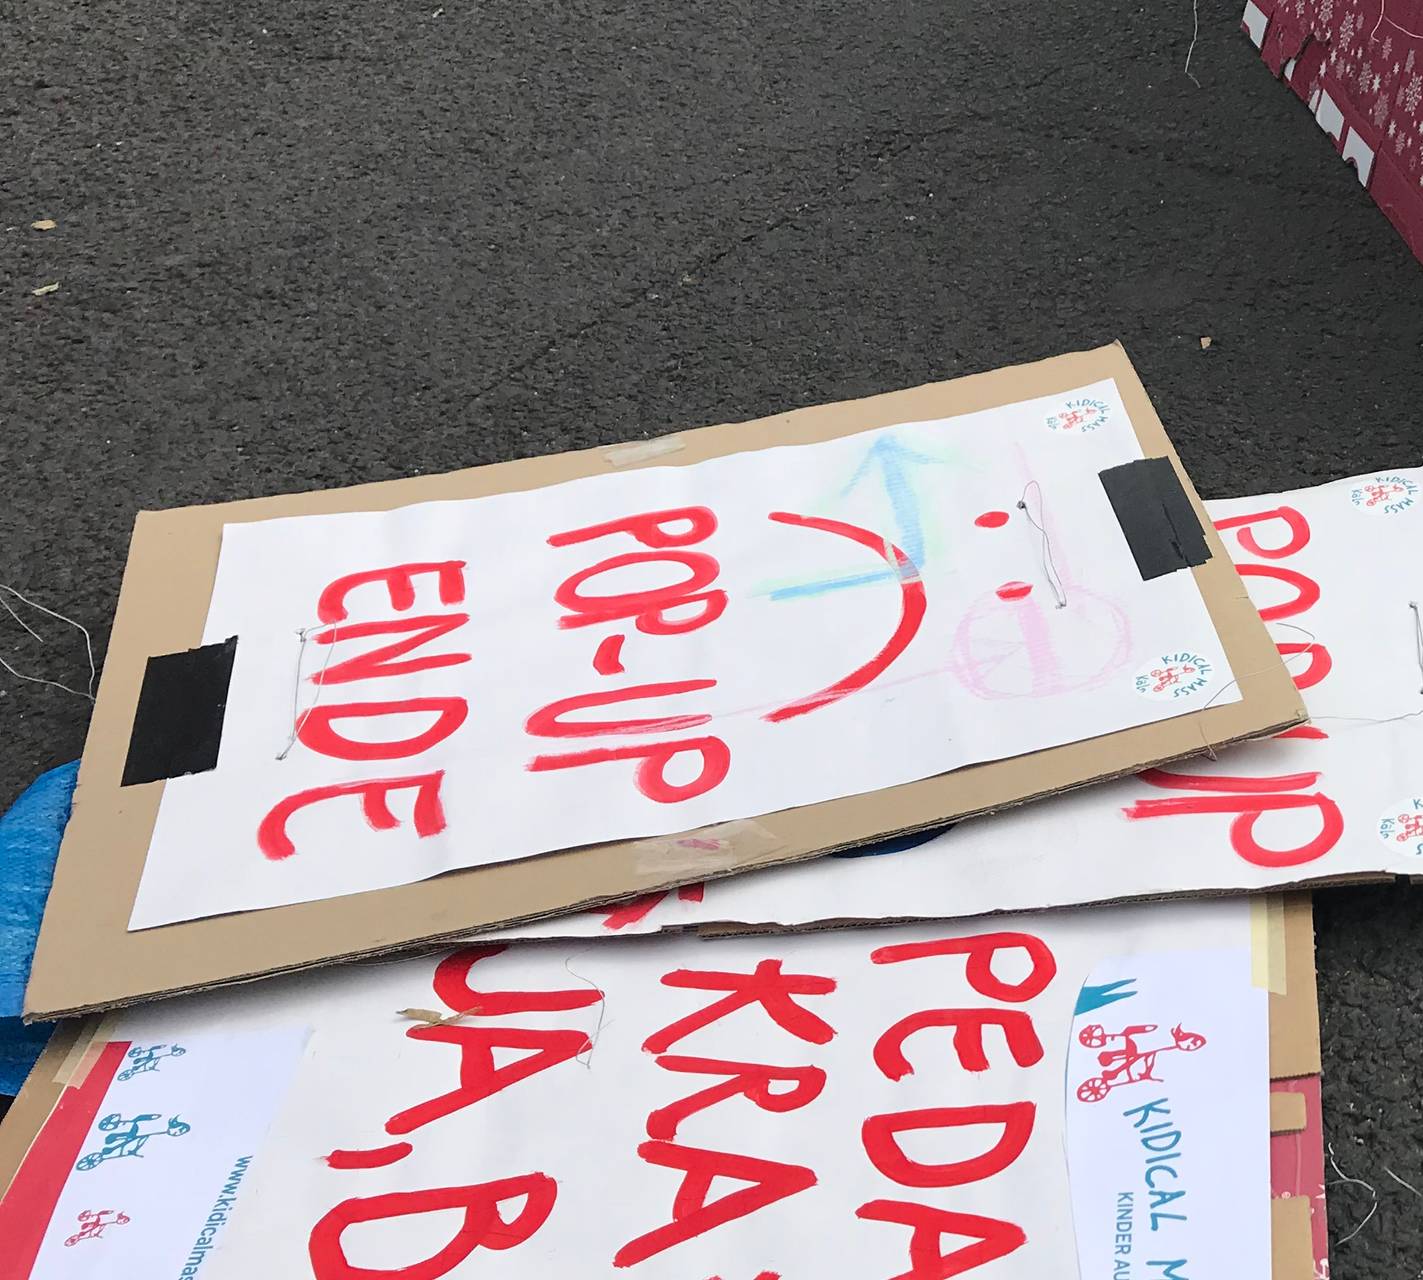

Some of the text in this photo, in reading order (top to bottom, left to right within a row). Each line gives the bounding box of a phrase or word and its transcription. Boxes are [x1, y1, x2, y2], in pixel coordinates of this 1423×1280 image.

[257, 560, 472, 861] ENDE
[526, 506, 731, 803] POP-UP
[1161, 652, 1213, 698] KIDICAL MASS
[613, 960, 837, 1280] KRA
[1114, 1191, 1134, 1255] KINDER
[1122, 1097, 1188, 1232] KIDICAL
